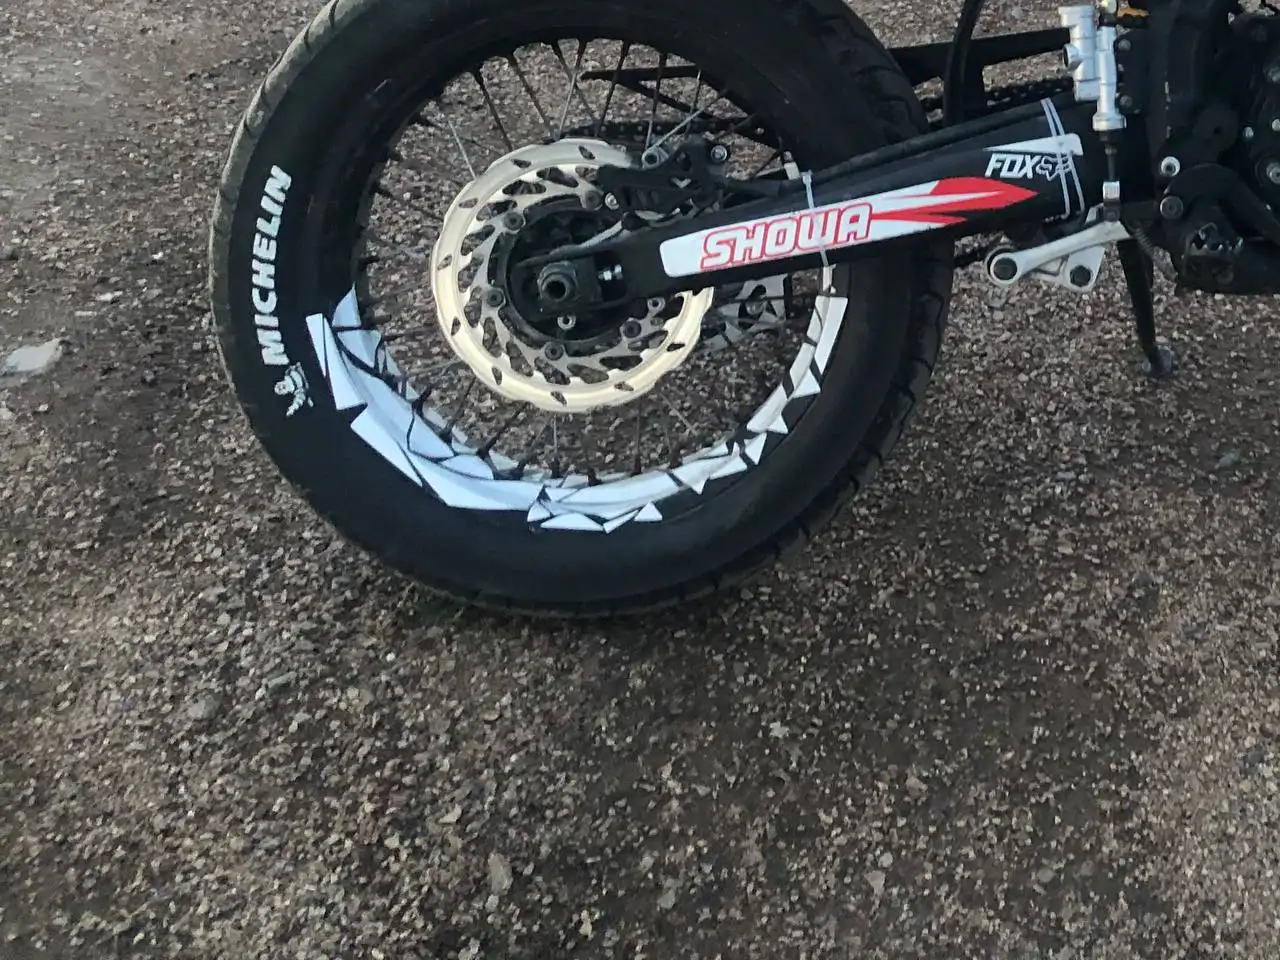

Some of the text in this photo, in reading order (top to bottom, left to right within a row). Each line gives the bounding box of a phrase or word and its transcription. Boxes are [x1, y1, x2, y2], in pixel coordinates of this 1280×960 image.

[985, 153, 1041, 179] FOX
[251, 164, 292, 366] MICHELIN
[701, 204, 873, 270] SHOWA
